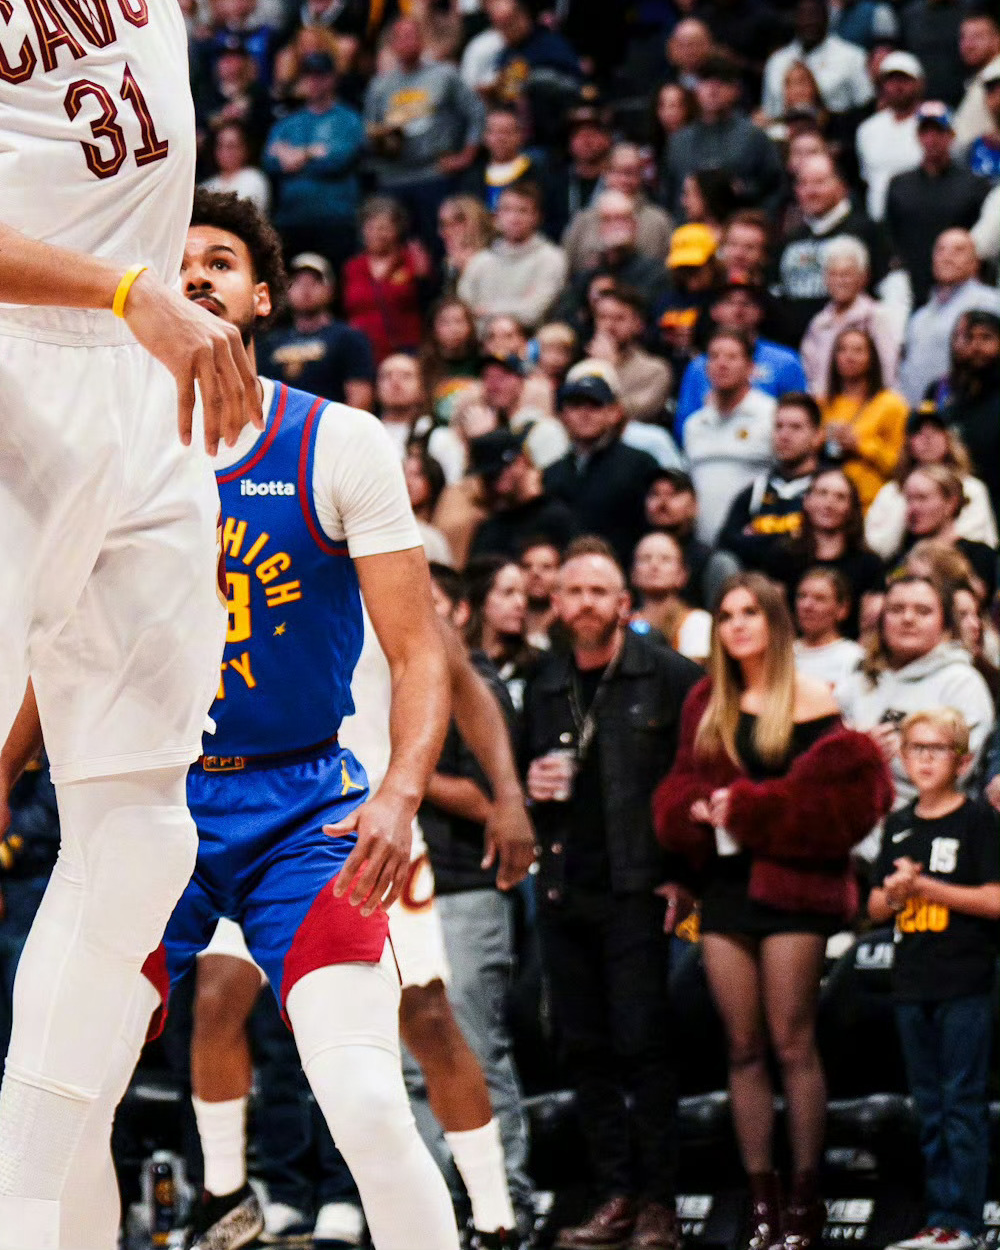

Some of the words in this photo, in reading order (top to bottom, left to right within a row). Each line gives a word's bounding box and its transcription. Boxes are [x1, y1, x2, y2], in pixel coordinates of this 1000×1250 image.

[63, 62, 169, 180] 31
[240, 479, 296, 497] ibotta
[222, 516, 303, 608] HIGH
[929, 836, 960, 873] 15
